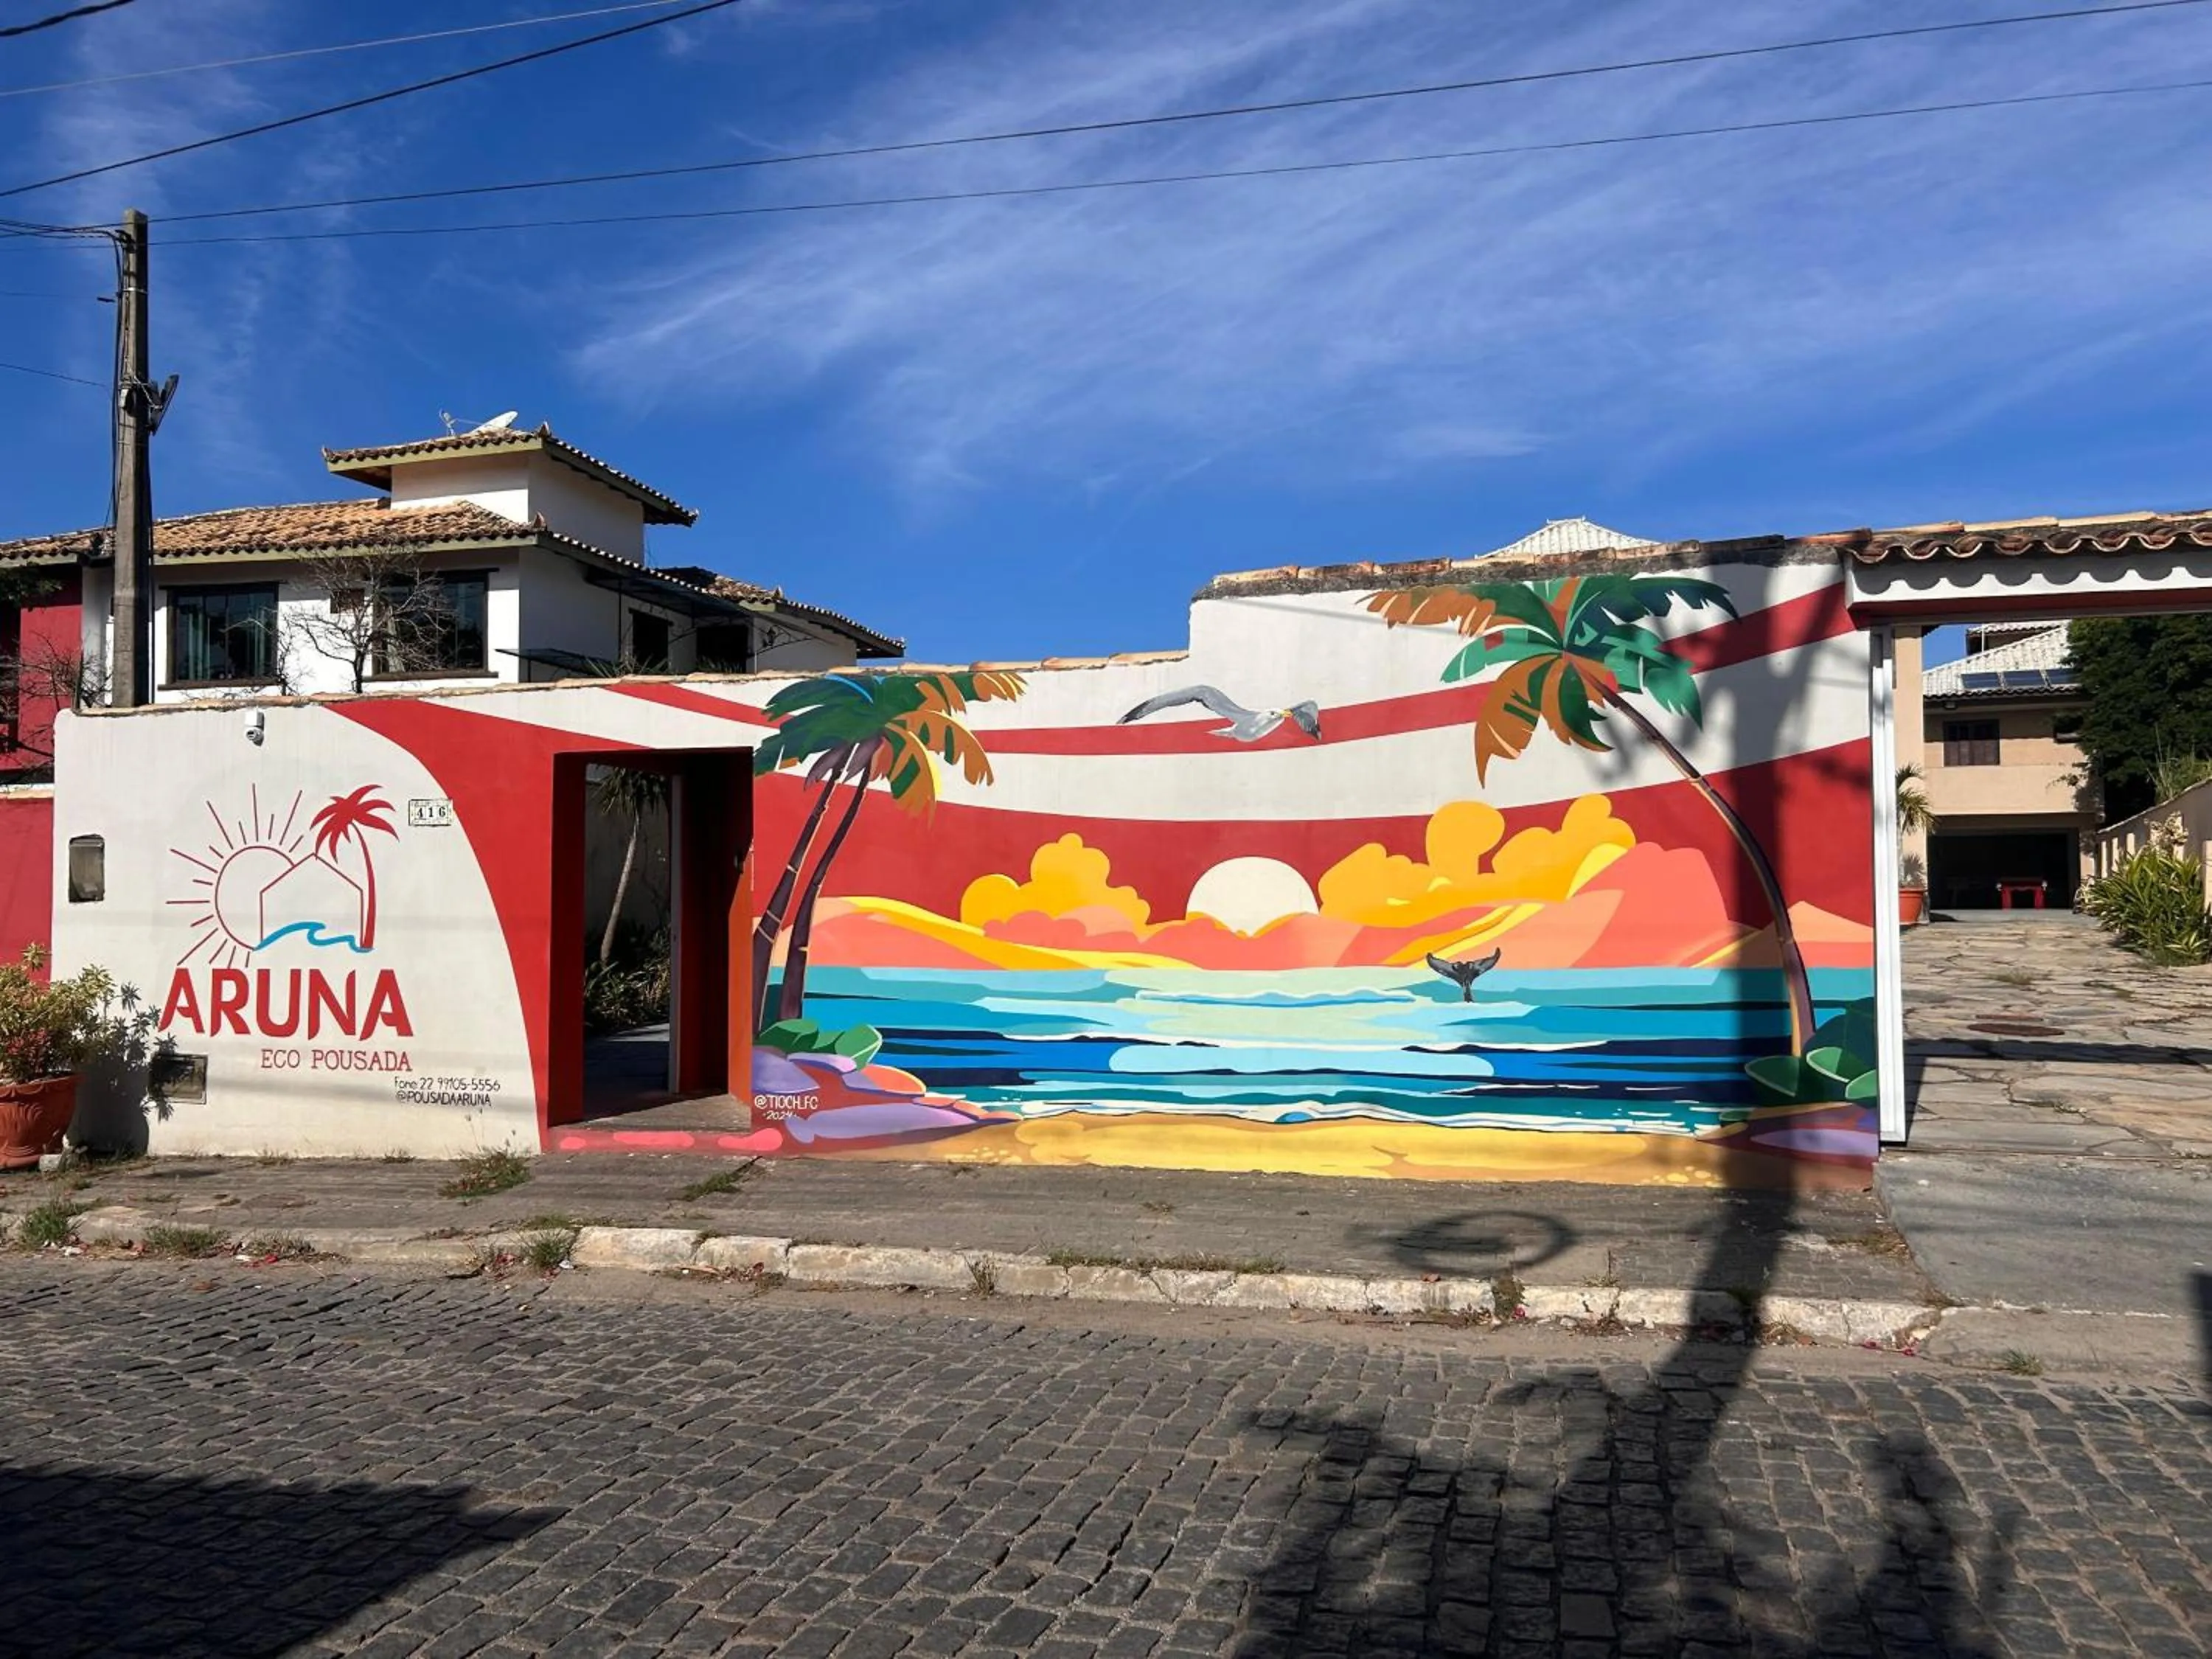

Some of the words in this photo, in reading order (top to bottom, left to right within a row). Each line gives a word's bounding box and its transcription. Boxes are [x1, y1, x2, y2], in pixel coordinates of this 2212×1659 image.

[417, 807, 446, 818] 416
[158, 968, 414, 1042] ARUNA
[260, 1048, 301, 1068] ECO
[311, 1049, 413, 1072] POUSADA
[420, 1077, 434, 1091] 22
[396, 1090, 492, 1106] @POUSADAARUNA
